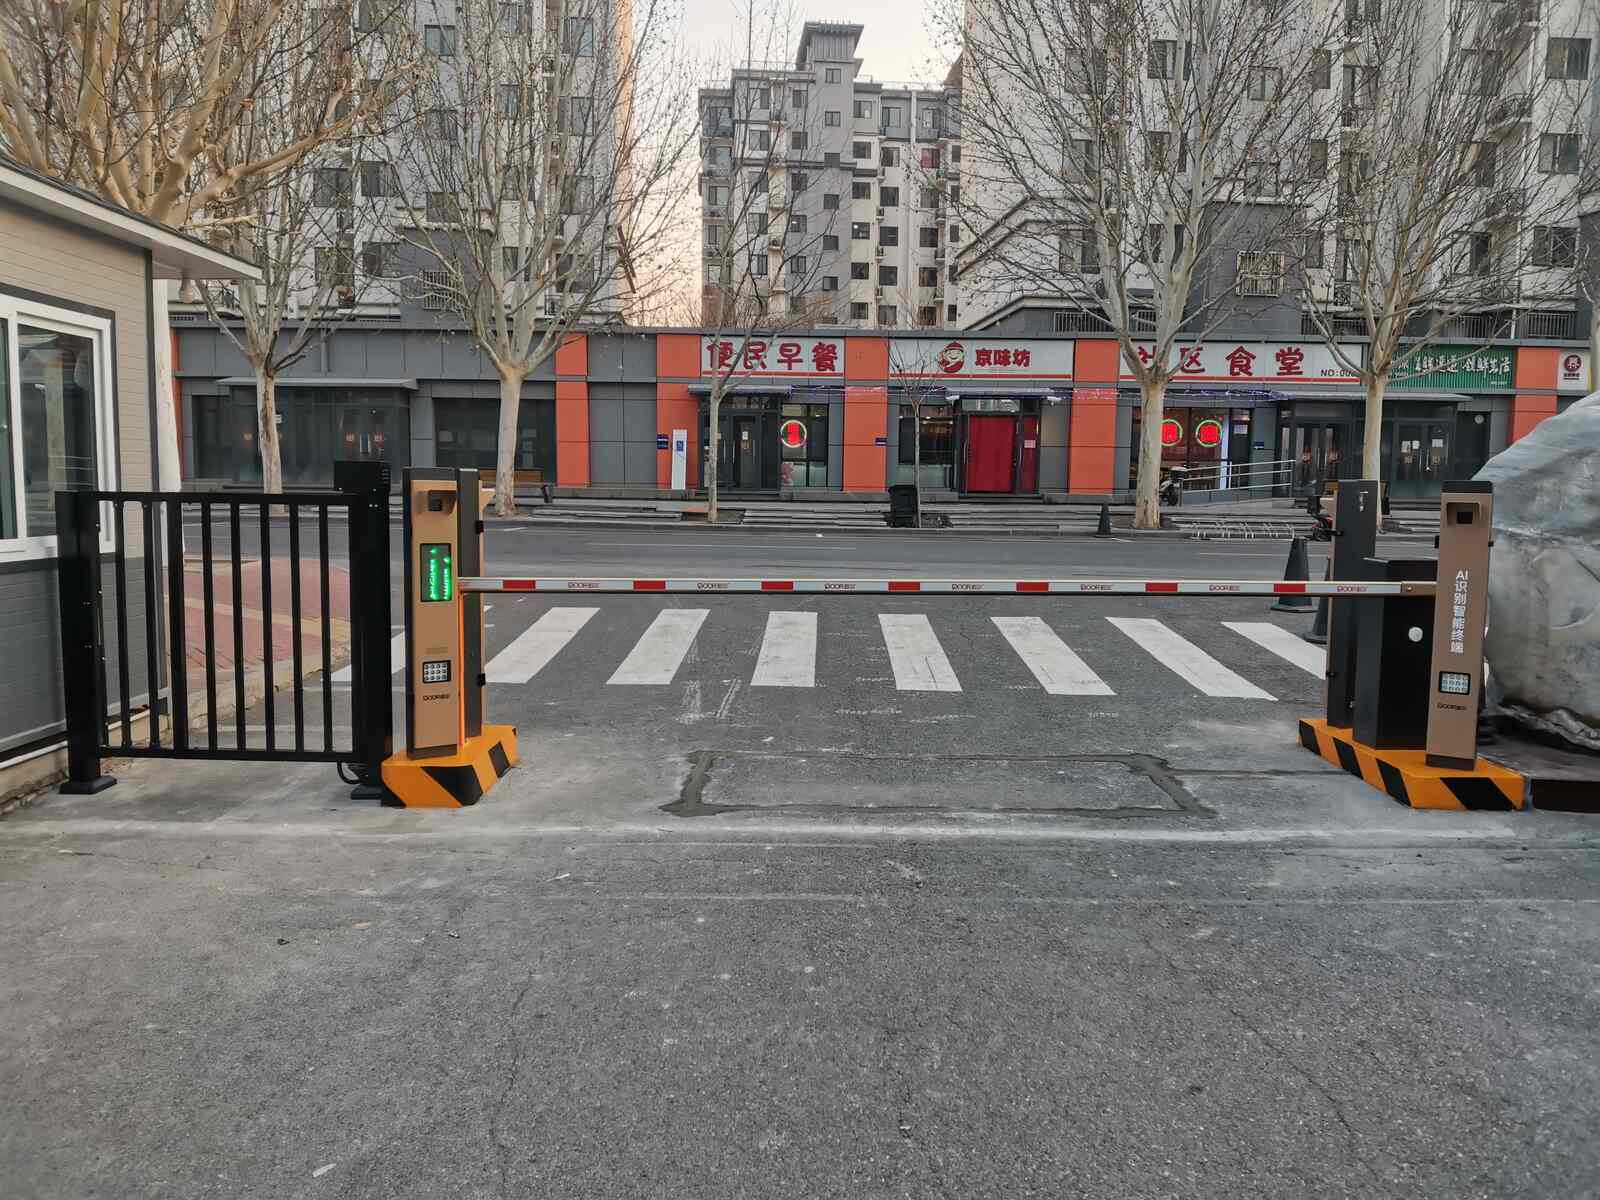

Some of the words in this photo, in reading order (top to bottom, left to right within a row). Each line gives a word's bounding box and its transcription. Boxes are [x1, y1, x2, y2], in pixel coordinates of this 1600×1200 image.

[706, 341, 838, 371] 便民早餐
[976, 348, 1030, 367] 京味坊
